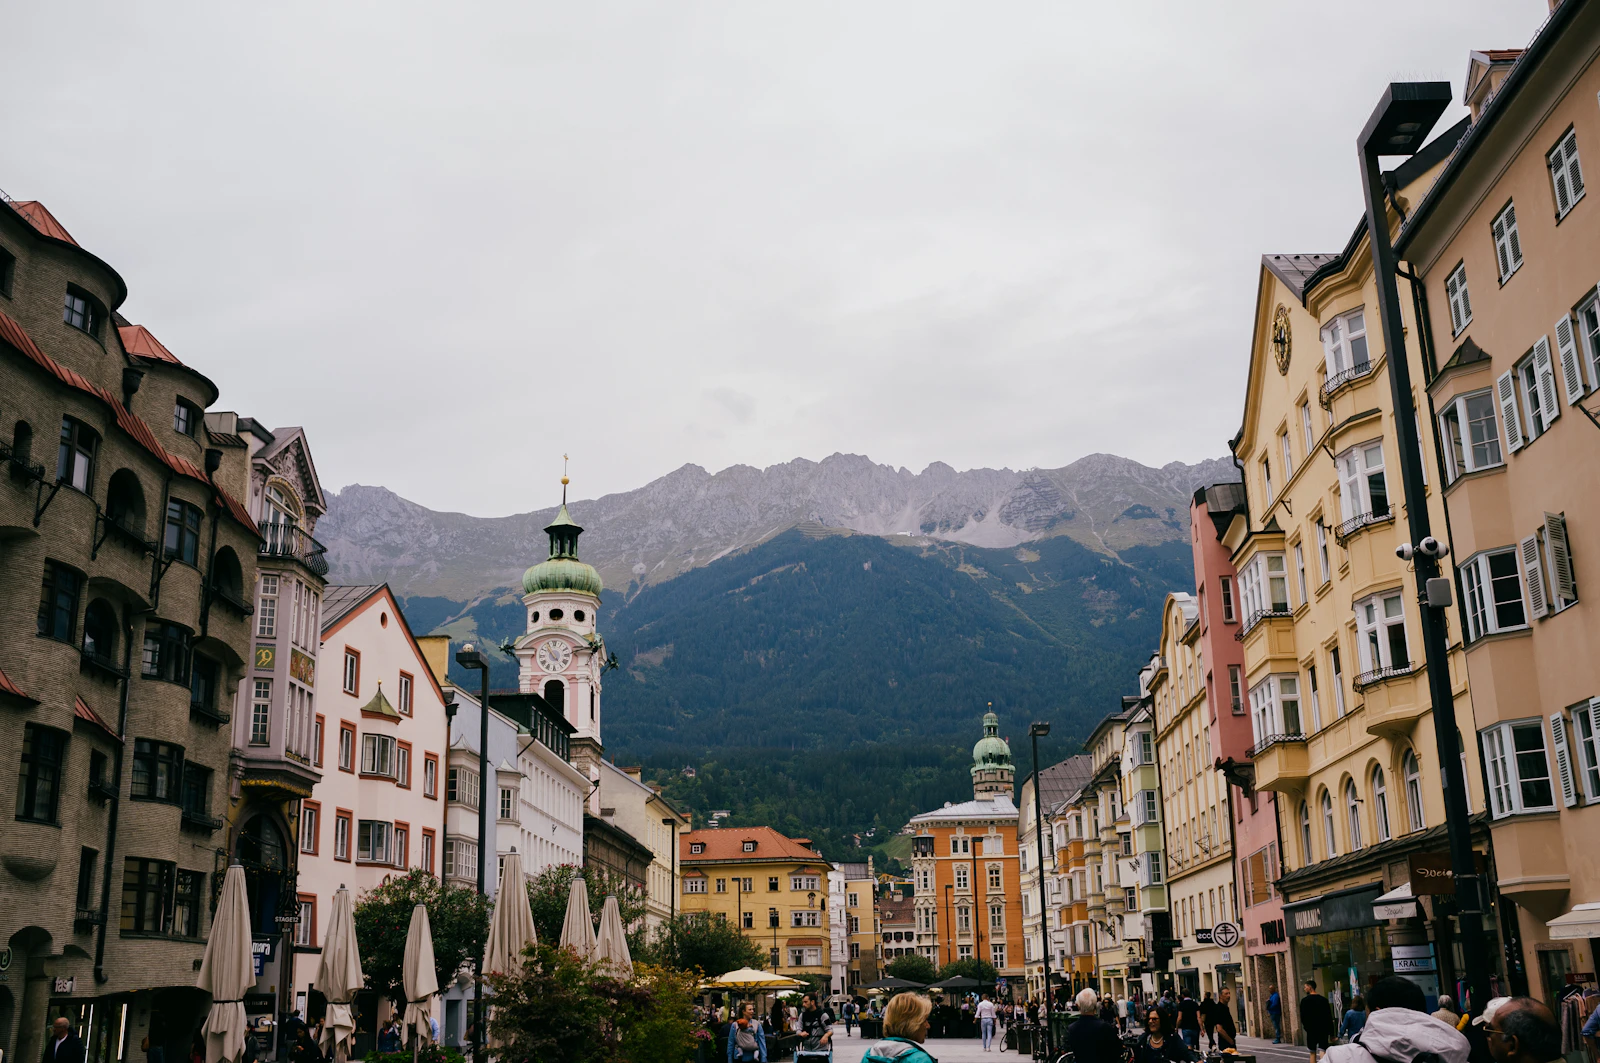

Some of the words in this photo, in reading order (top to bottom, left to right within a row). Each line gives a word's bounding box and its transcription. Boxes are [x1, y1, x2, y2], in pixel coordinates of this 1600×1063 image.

[1416, 868, 1453, 879] Weig
[1295, 908, 1322, 930] HUMANIC
[1398, 960, 1419, 968] KRAL
